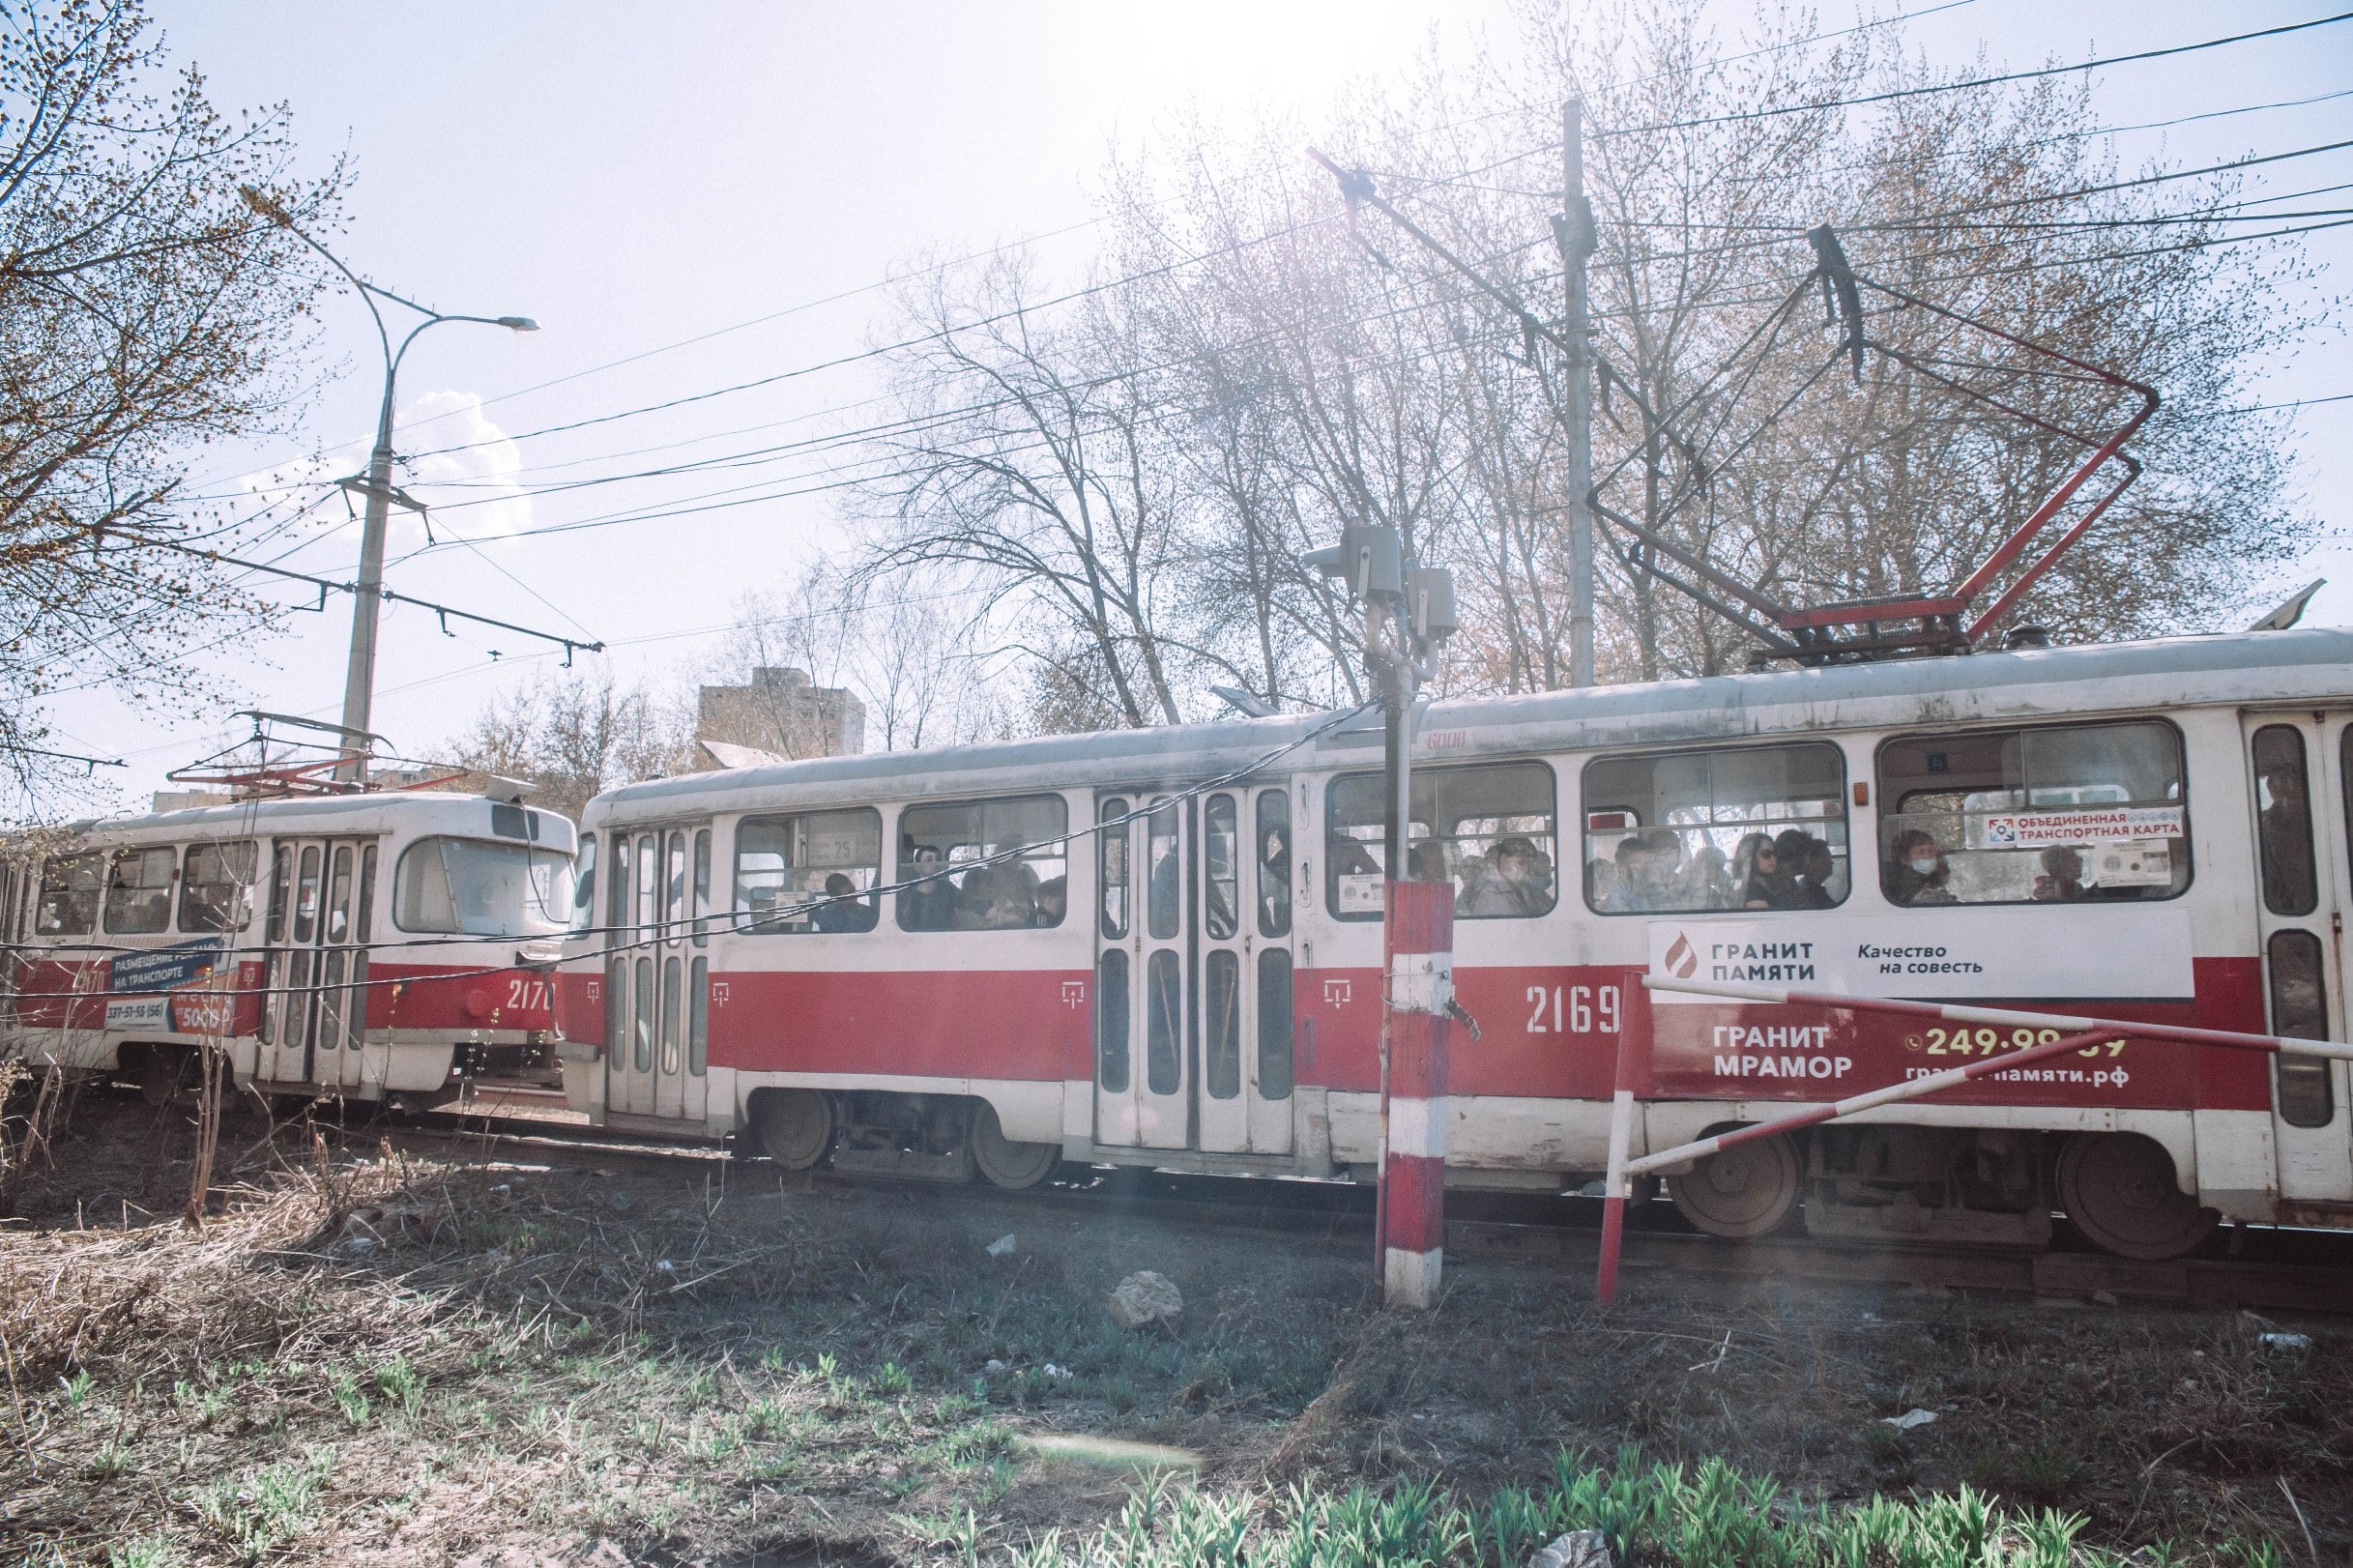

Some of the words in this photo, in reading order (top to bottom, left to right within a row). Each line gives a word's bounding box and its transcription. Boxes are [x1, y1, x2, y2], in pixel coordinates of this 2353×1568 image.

[2019, 813, 2127, 828] ОБЪЕДИНЕННАЯ
[2019, 825, 2130, 839] ТРАНСПОРТНАЯ
[2134, 823, 2180, 835] КАРТА
[1711, 943, 1814, 960] ГРАНИТ
[1857, 944, 1948, 959] Качество
[114, 951, 174, 973] РАЗМЕЩЕНИЕ
[1879, 962, 1903, 974] на
[1906, 961, 1984, 974] совесть
[114, 976, 128, 990] НА
[129, 966, 184, 987] ТРАНСПОРТЕ
[1712, 964, 1816, 981] ПАМЯТИ
[1526, 985, 1620, 1033] 2169
[1713, 1026, 1830, 1049] ГРАНИТ
[1714, 1055, 1853, 1079] МРАМОР
